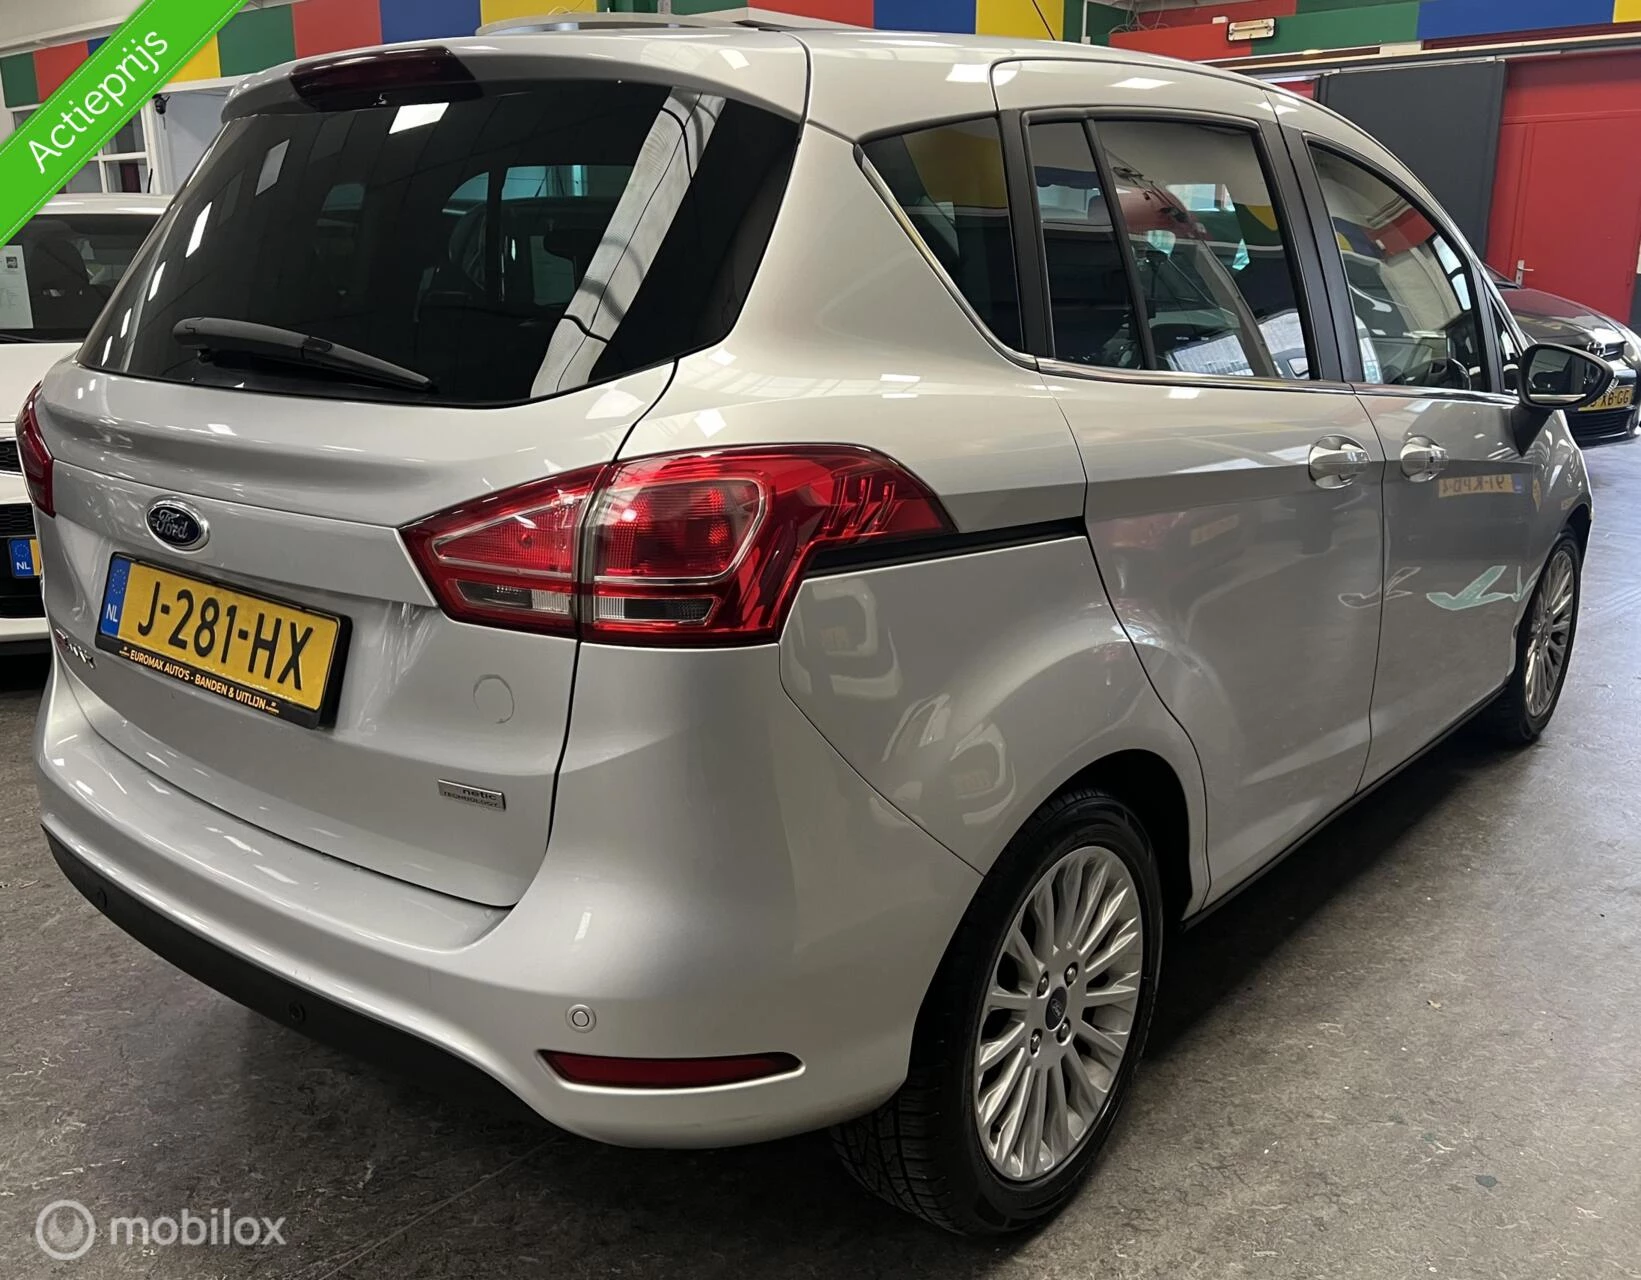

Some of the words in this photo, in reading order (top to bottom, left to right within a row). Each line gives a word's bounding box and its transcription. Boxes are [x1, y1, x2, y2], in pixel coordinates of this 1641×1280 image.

[152, 509, 189, 539] Ford
[16, 561, 31, 570] NL
[106, 603, 118, 623] NL
[137, 581, 314, 690] J-281-HX
[130, 650, 164, 671] EUROMAX
[164, 663, 190, 681] AUTO'S
[194, 674, 228, 695] BANDEN
[228, 687, 235, 698] &
[235, 690, 266, 710] UITLIJN
